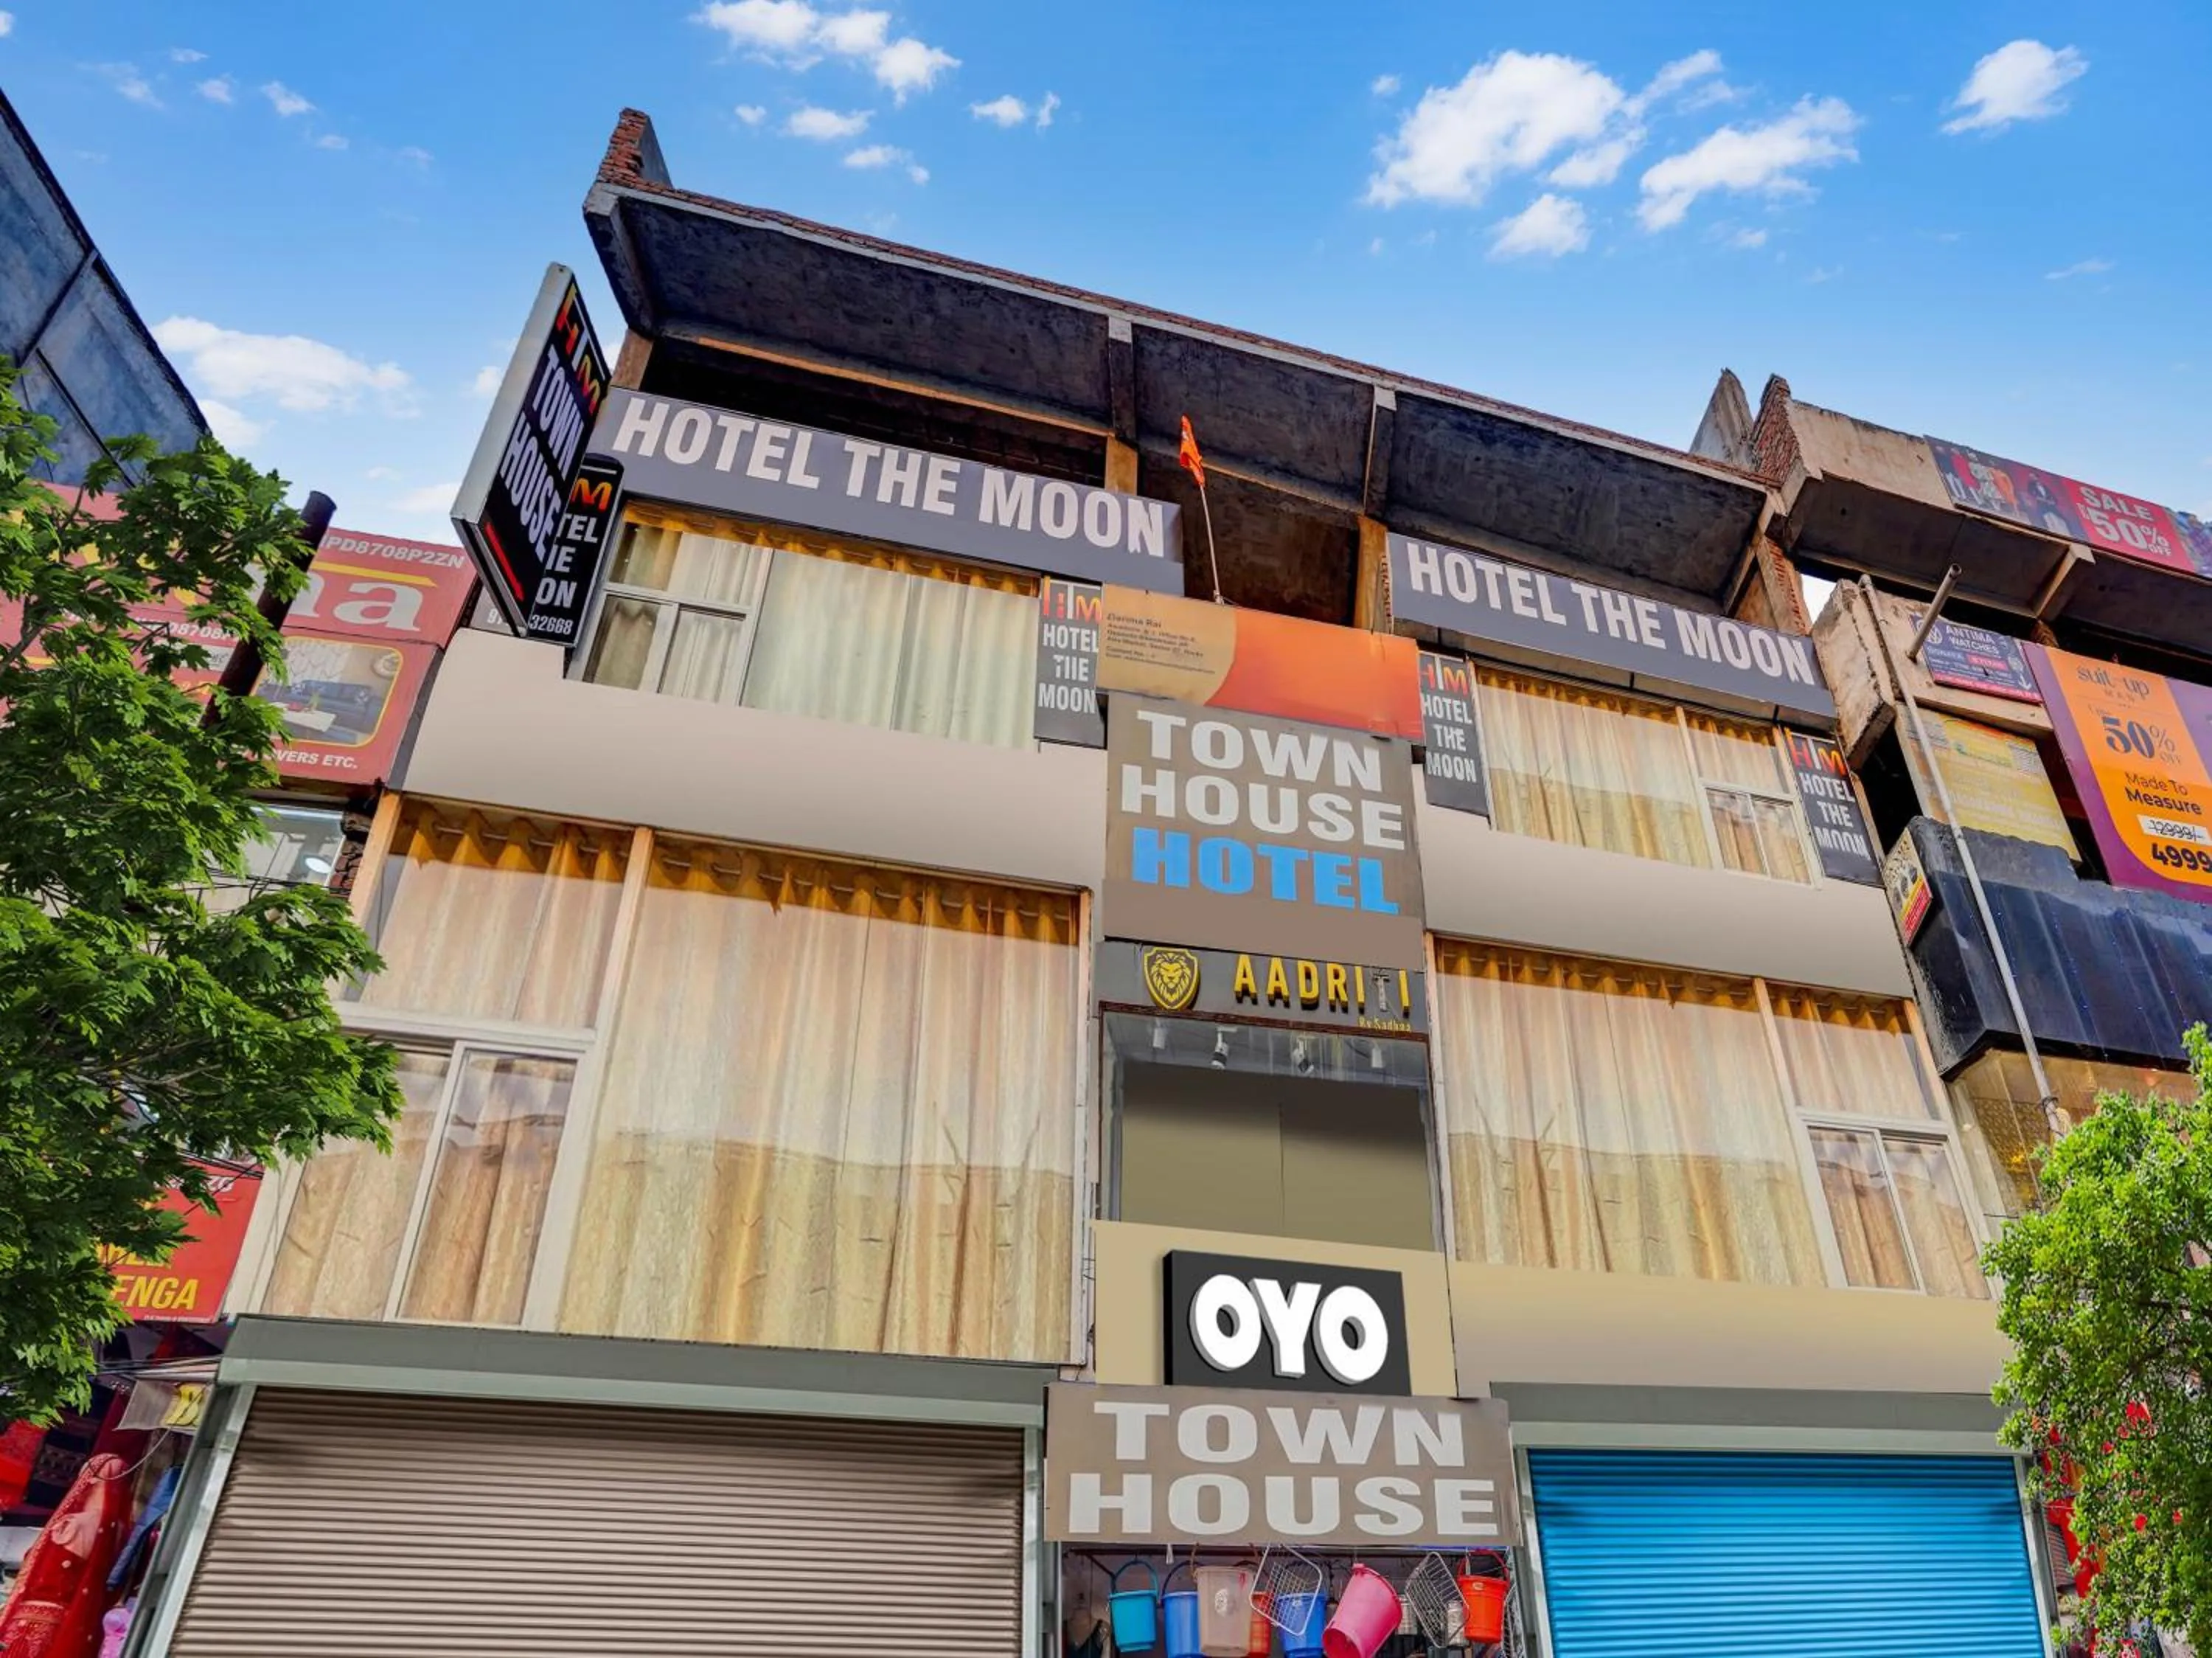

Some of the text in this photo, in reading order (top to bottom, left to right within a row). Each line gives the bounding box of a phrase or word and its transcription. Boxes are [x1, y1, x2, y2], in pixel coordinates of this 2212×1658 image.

[532, 344, 585, 481] TOWN
[500, 412, 562, 563] HOUSE
[612, 398, 1164, 558] HOTEL THE MOON
[2079, 486, 2154, 521] SALE
[557, 513, 598, 543] TEL
[535, 577, 577, 608] ON
[1406, 542, 1816, 686] HOTEL THE MOON
[1043, 623, 1099, 653] HOTEL
[1038, 682, 1096, 714] MOON
[1421, 693, 1473, 724] HOTEL
[1137, 710, 1382, 793] TOWN
[1433, 724, 1467, 752] THE
[322, 755, 358, 769] ETC.
[1426, 751, 1478, 783] MOON
[1799, 772, 1856, 803] HOTEL
[2124, 785, 2202, 815] Measure
[2125, 771, 2188, 796] Made To
[1121, 765, 1405, 850] HOUSE
[1816, 801, 1854, 828] THE
[1814, 826, 1871, 861] MOON
[1132, 827, 1400, 915] HOTEL
[111, 1274, 200, 1310] ENGA
[1189, 1274, 1389, 1385] OYO
[1093, 1401, 1465, 1467] TOWN
[1068, 1473, 1499, 1536] HOUSE
